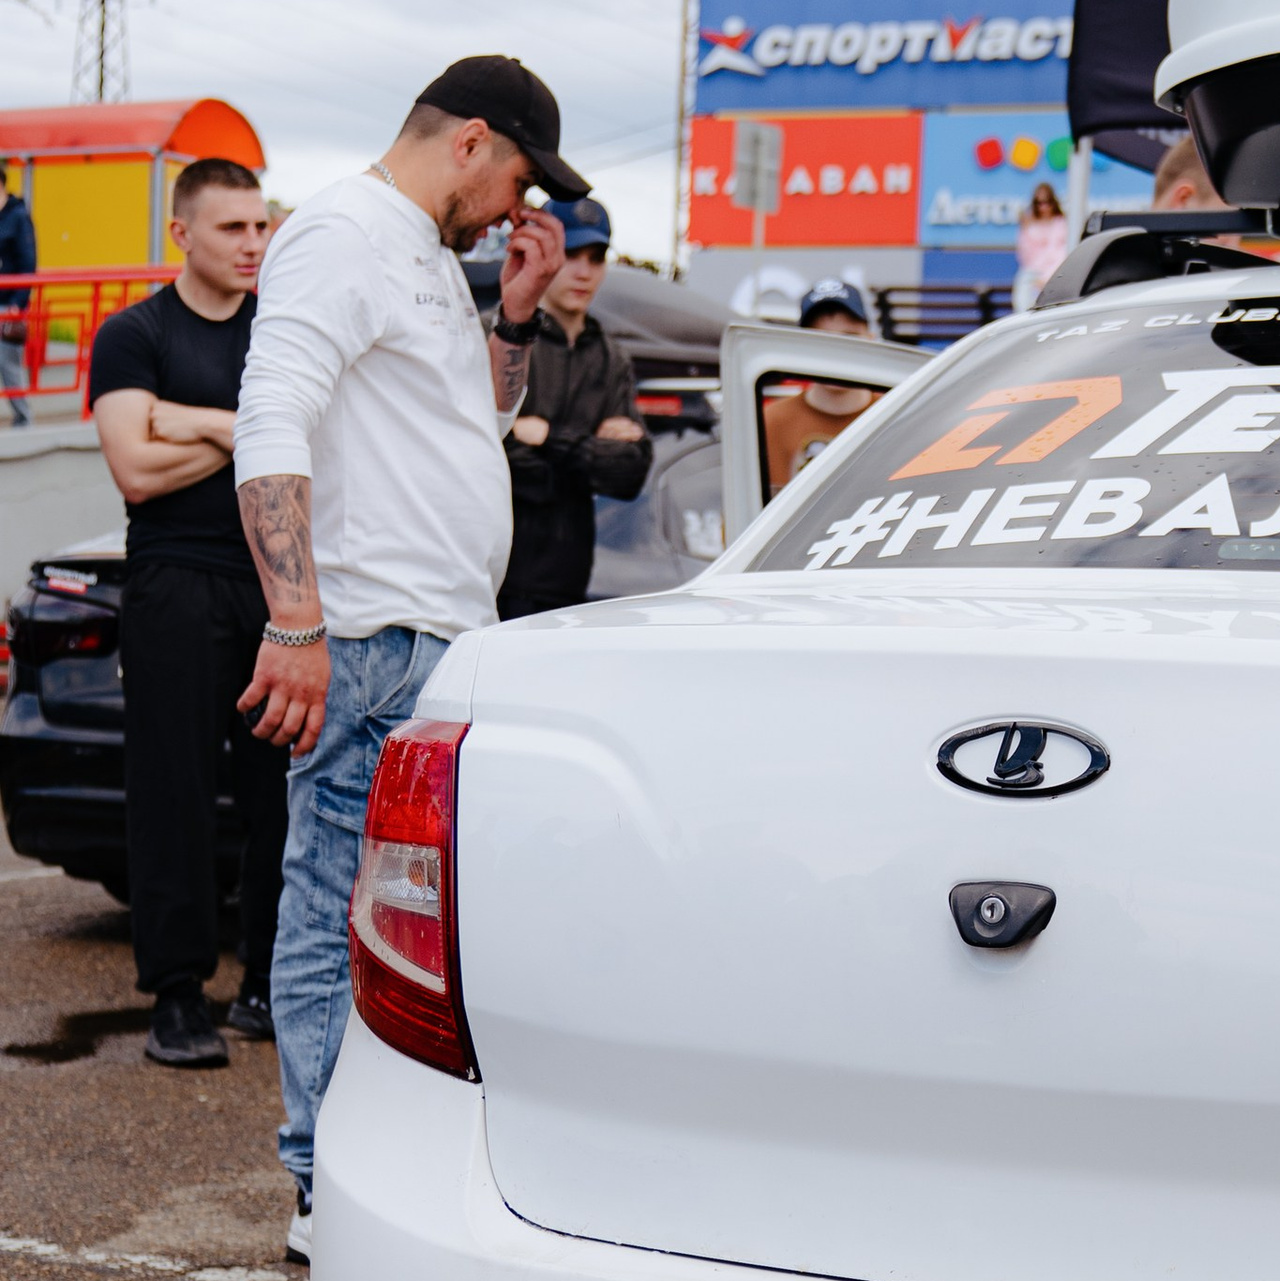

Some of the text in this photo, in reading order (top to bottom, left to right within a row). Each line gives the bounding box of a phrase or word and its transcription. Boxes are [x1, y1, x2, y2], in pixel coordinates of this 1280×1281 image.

[693, 164, 912, 195] КАВАН
[1037, 307, 1279, 342] TAZ CLUB
